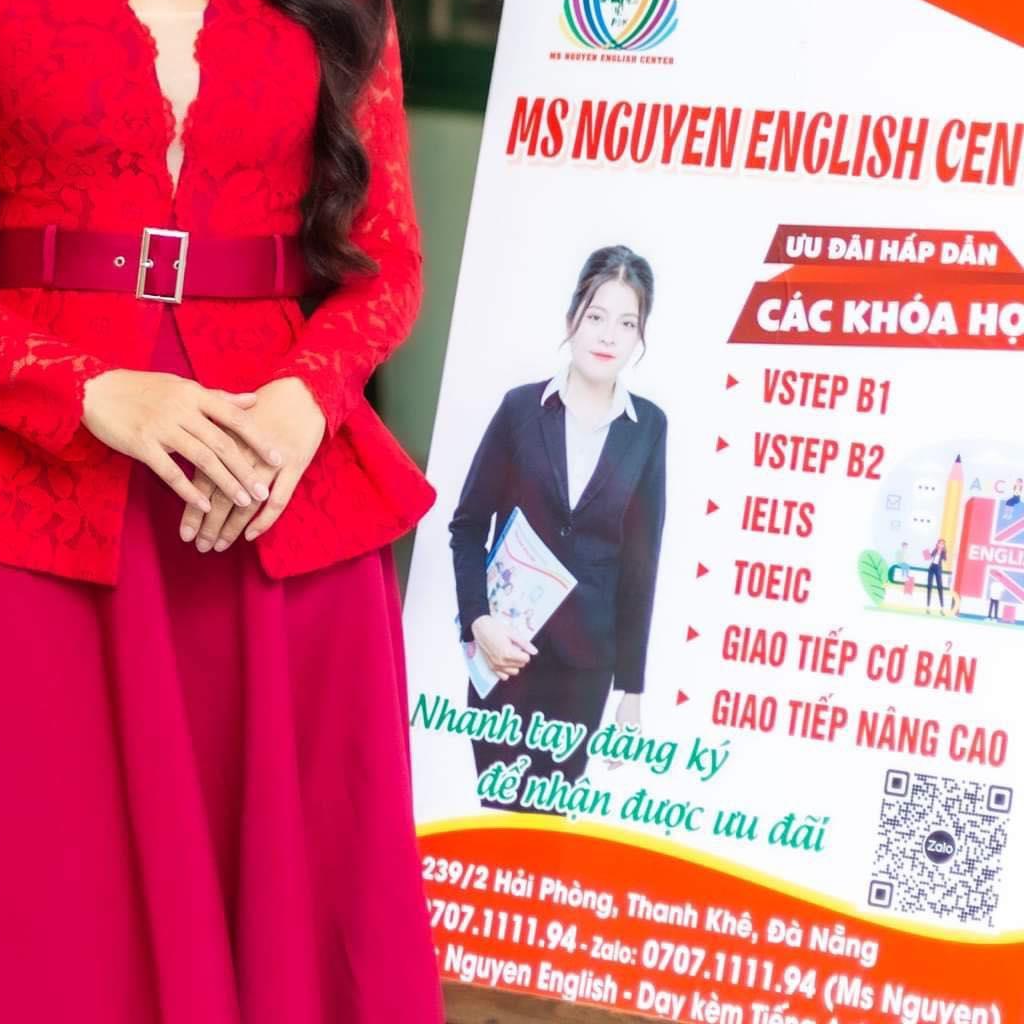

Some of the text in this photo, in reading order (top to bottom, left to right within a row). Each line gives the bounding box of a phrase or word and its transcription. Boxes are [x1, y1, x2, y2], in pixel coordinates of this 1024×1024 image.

[506, 96, 569, 158] MS
[572, 100, 742, 168] NGUYEN
[744, 109, 930, 180] ENGLISH
[786, 232, 998, 267] ƯU ĐÃI HẤP DẪN
[757, 291, 833, 333] CÁC
[842, 292, 959, 336] KHÓA
[763, 368, 891, 415] VSTEP B1
[753, 432, 885, 480] VSTEP B2
[742, 495, 815, 538] IELTS
[733, 560, 812, 604] TOEIC
[721, 624, 977, 694] GIAO TIẾP CƠ BẢN
[411, 693, 731, 782] Nhanh tay đăng ký
[712, 689, 1009, 768] GIAO TIẾP NÂNG CAO
[477, 758, 831, 852] để nhận được ưu đãi
[927, 839, 953, 855] Zalo
[422, 856, 879, 968] 239/2 Hải Phòng, Thanh Khê, Đà Nẵng
[426, 896, 577, 953] 707.1111.94
[591, 936, 636, 965] Zalo:
[642, 938, 816, 999] 0707.1111.94
[824, 974, 874, 1012] (Ms
[445, 944, 532, 986] Nguyen
[537, 962, 617, 1002] English
